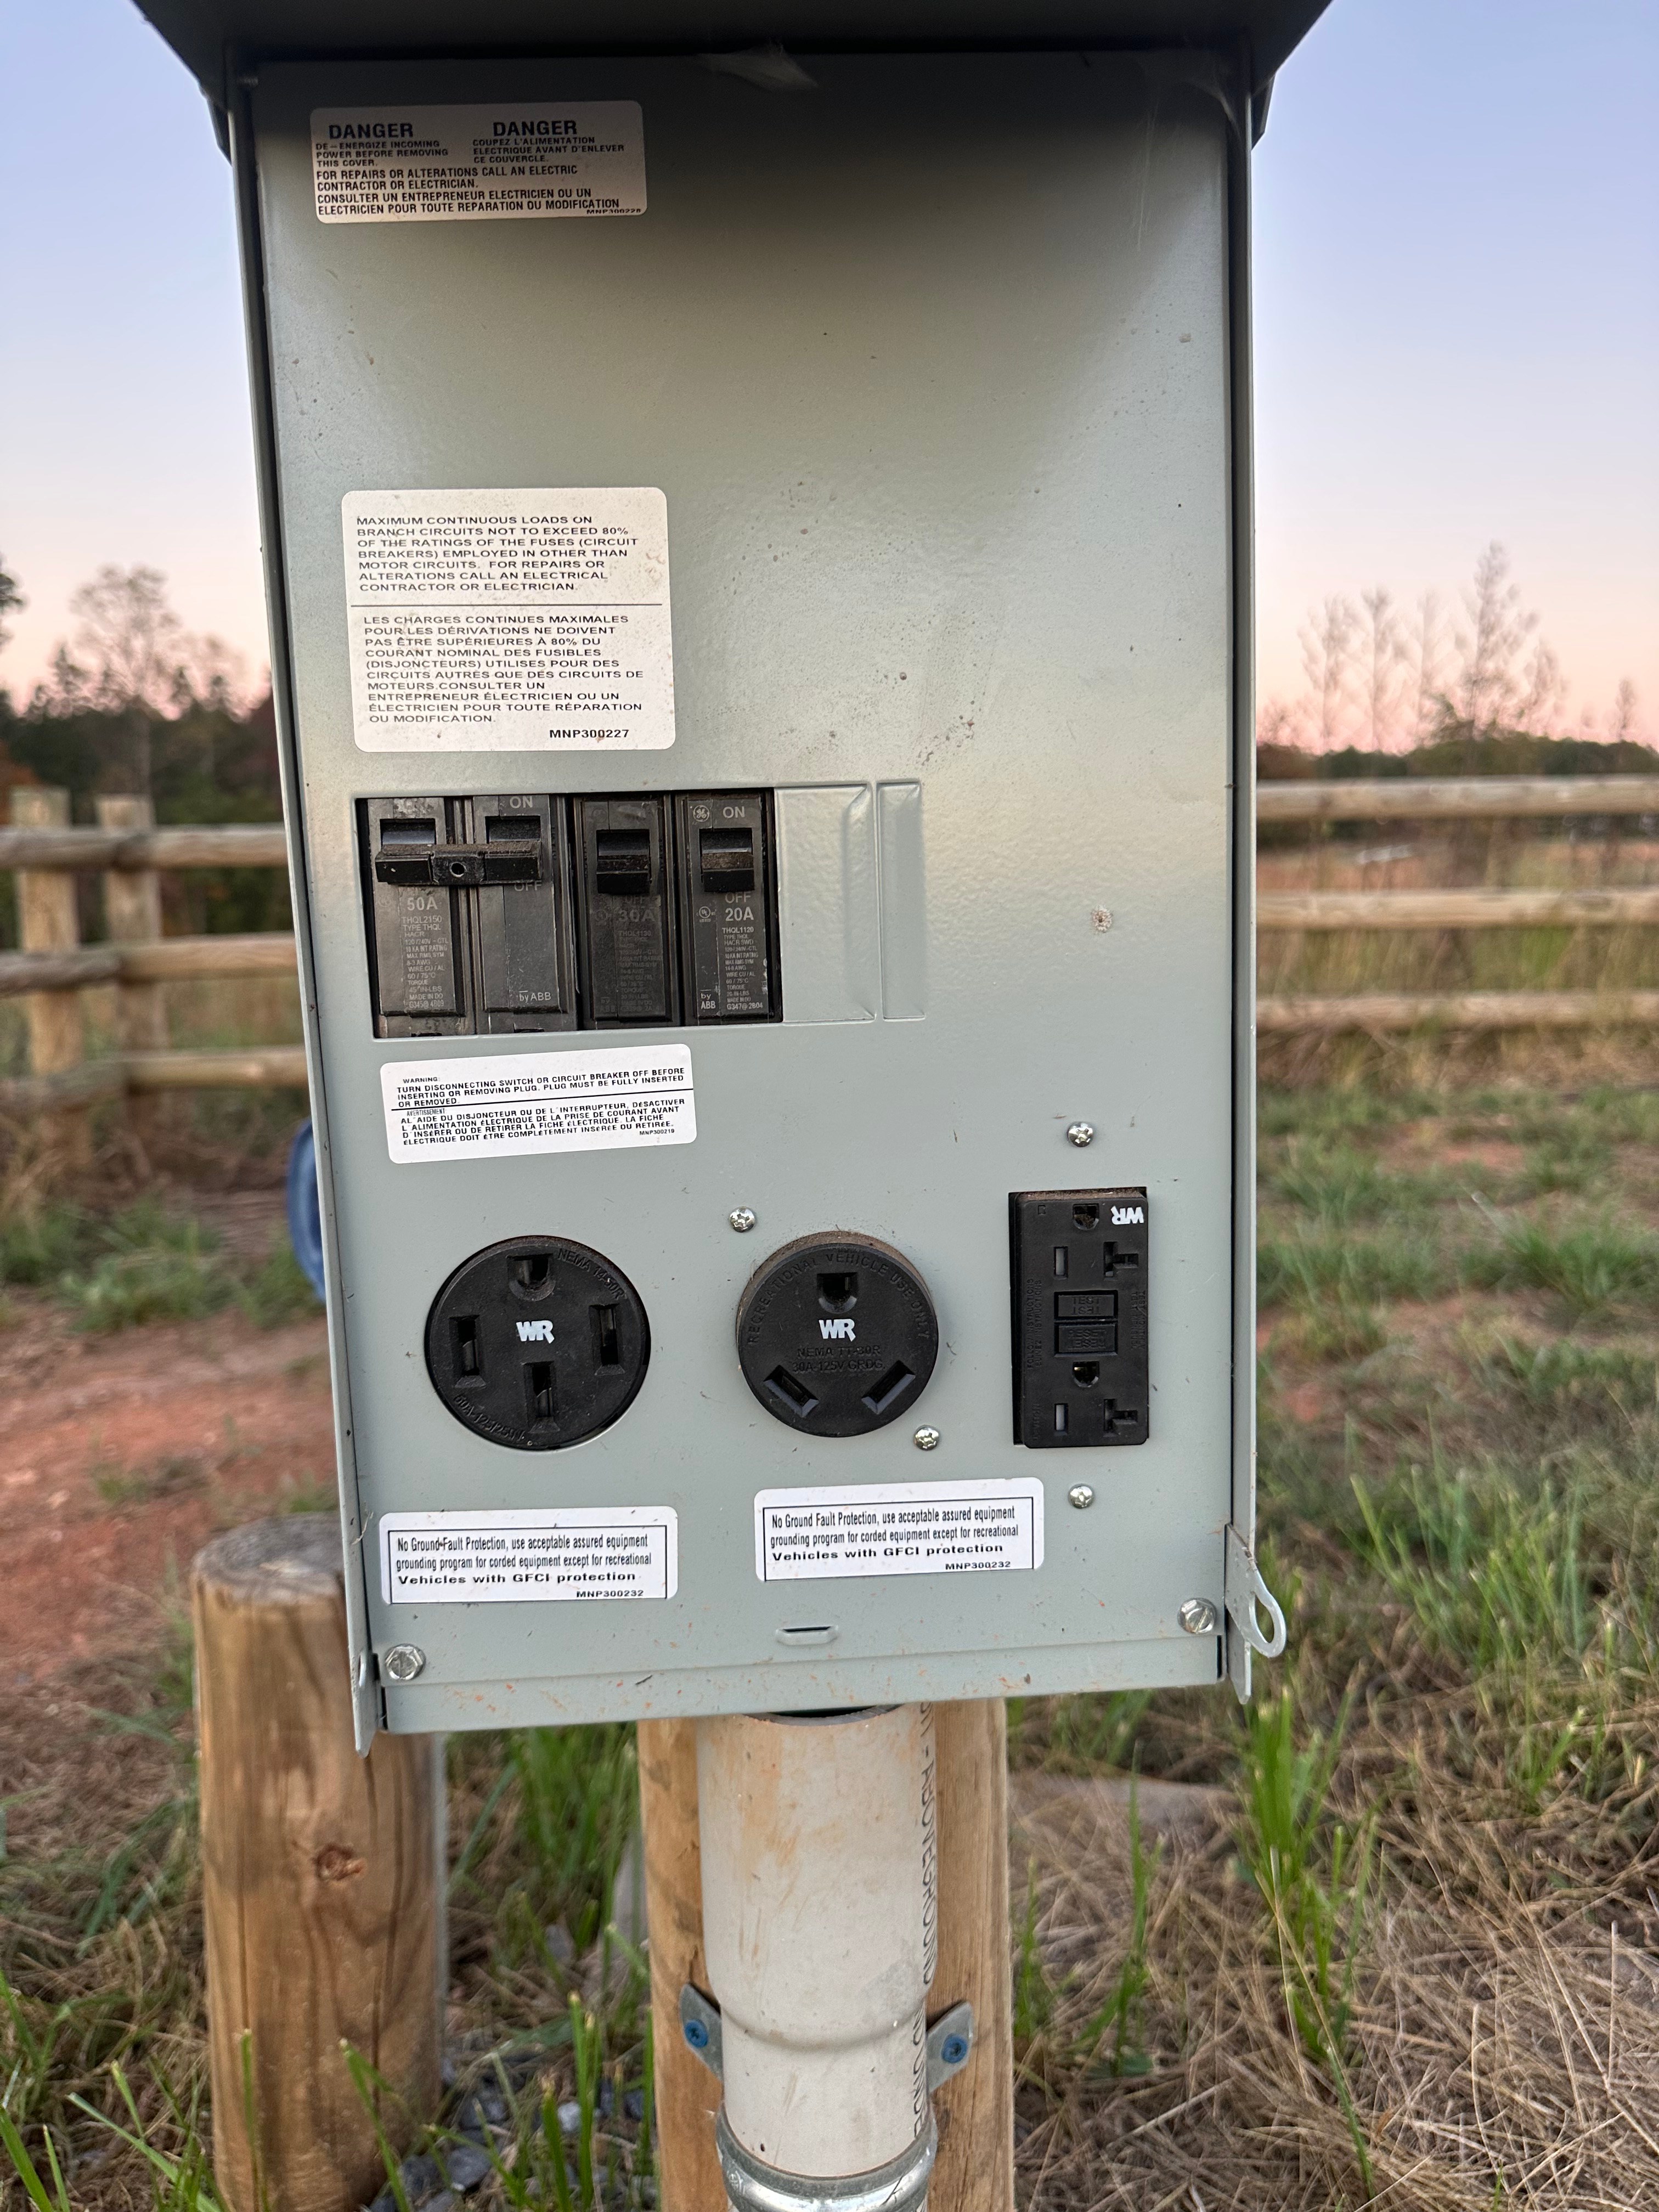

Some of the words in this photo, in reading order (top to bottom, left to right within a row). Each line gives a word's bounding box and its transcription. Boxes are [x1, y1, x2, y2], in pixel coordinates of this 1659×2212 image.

[328, 122, 414, 140] DANGER
[493, 120, 577, 137] DANGER
[316, 149, 352, 159] POWER
[355, 149, 393, 158] BEFORE
[396, 149, 448, 157] REMOVING
[473, 146, 532, 155] ELECTRIQUE
[534, 145, 568, 154] AVANT
[571, 144, 624, 153] D'ENLEVER
[317, 159, 339, 167] THIS
[317, 170, 337, 180] FOR
[340, 169, 386, 180] REPAIRS
[389, 168, 404, 179] OR
[408, 167, 478, 179] ALTERATIONS
[482, 166, 507, 176] CALL
[511, 166, 525, 176] AN
[529, 165, 578, 175] ELECTRIC
[357, 516, 422, 525] MAXIMUM
[427, 516, 517, 524] CONTINUOUS
[573, 516, 592, 524] ON
[357, 528, 415, 537] BRANCH
[411, 539, 472, 547] RATINGS
[499, 538, 526, 546] THE
[579, 538, 638, 547] (CIRCUIT
[549, 729, 629, 738] MNP300227
[509, 795, 533, 809] ON
[722, 806, 746, 819] ON
[407, 896, 438, 911] 50A
[724, 893, 752, 904] OFF
[618, 908, 656, 923] 30A
[725, 906, 754, 922] 20A
[721, 926, 754, 934] THQL1120
[518, 992, 529, 1004] by
[530, 991, 551, 1001] ABB
[700, 992, 712, 1000] by
[701, 1001, 716, 1009] ABB
[425, 1081, 496, 1091] DISCONNECTING
[499, 1077, 533, 1086] SWITCH
[552, 1074, 586, 1083] CIRCUIT
[590, 1071, 630, 1080] BREAKER
[633, 1070, 648, 1079] OFF
[652, 1068, 684, 1077] BEFORE
[1110, 1205, 1145, 1225] WR
[556, 1248, 591, 1273] NEMA
[825, 1252, 891, 1277] VEHICLE
[891, 1272, 915, 1300] USE
[1071, 1296, 1102, 1305] TEST
[515, 1319, 555, 1345] WR
[818, 1317, 857, 1342] WR
[797, 1347, 834, 1358] NEMA
[772, 1514, 782, 1528] No
[785, 1513, 813, 1528] Ground
[816, 1512, 836, 1527] Fault
[882, 1513, 895, 1524] use
[898, 1508, 939, 1525] acceptable
[942, 1507, 971, 1522] assured
[974, 1505, 1015, 1523] equipment
[397, 1537, 408, 1552] No
[511, 1538, 525, 1550] use
[528, 1534, 570, 1551] acceptable
[573, 1534, 603, 1549] assured
[606, 1533, 648, 1550] equipment
[770, 1533, 810, 1549] grounding
[812, 1533, 845, 1547] program
[848, 1531, 858, 1543] for
[861, 1530, 887, 1543] corded
[889, 1528, 930, 1544] equipment
[933, 1527, 957, 1542] except
[960, 1527, 970, 1538] for
[973, 1525, 1018, 1538] recreational
[772, 1550, 838, 1561] Vehicles
[844, 1549, 876, 1558] with
[883, 1547, 919, 1556] GFCI
[927, 1544, 1003, 1556] protection
[396, 1556, 437, 1573] grounding
[440, 1558, 473, 1571] program
[475, 1556, 487, 1568] for
[489, 1555, 516, 1568] corded
[519, 1554, 561, 1570] equipment
[563, 1554, 589, 1568] except
[591, 1553, 603, 1566] for
[605, 1552, 651, 1566] recreational
[945, 1561, 1011, 1570] MNP300232
[398, 1575, 466, 1585] Vehicles
[472, 1575, 506, 1583] with
[513, 1573, 549, 1582] GFCI
[557, 1572, 635, 1583] protection
